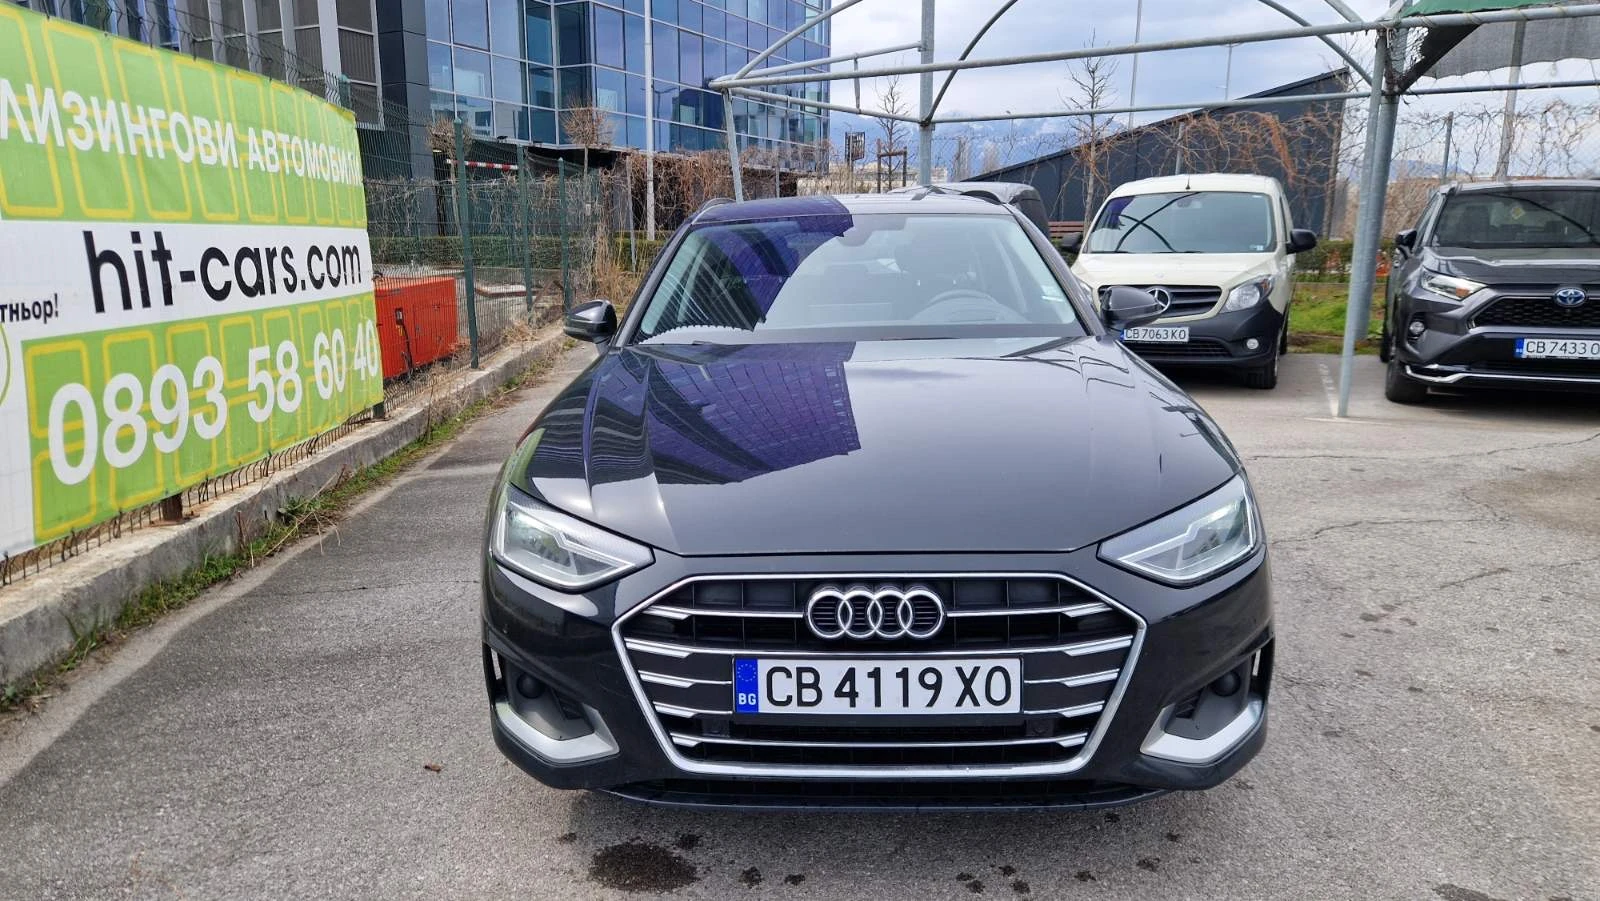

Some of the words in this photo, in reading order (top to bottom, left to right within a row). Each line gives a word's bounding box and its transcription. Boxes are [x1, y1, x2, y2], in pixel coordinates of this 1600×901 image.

[0, 78, 239, 169] ЛИЗИНГОВИ
[83, 230, 362, 313] hit-cars.com
[1142, 328, 1169, 340] 7063
[1526, 341, 1546, 354] CB
[1549, 341, 1587, 355] 7433
[48, 356, 228, 485] 0893
[247, 340, 302, 423] 58
[314, 328, 346, 400] 60
[354, 319, 378, 381] 40
[738, 693, 757, 705] BG
[766, 666, 823, 707] CB
[834, 666, 943, 708] 4119
[955, 665, 1012, 708] XO
